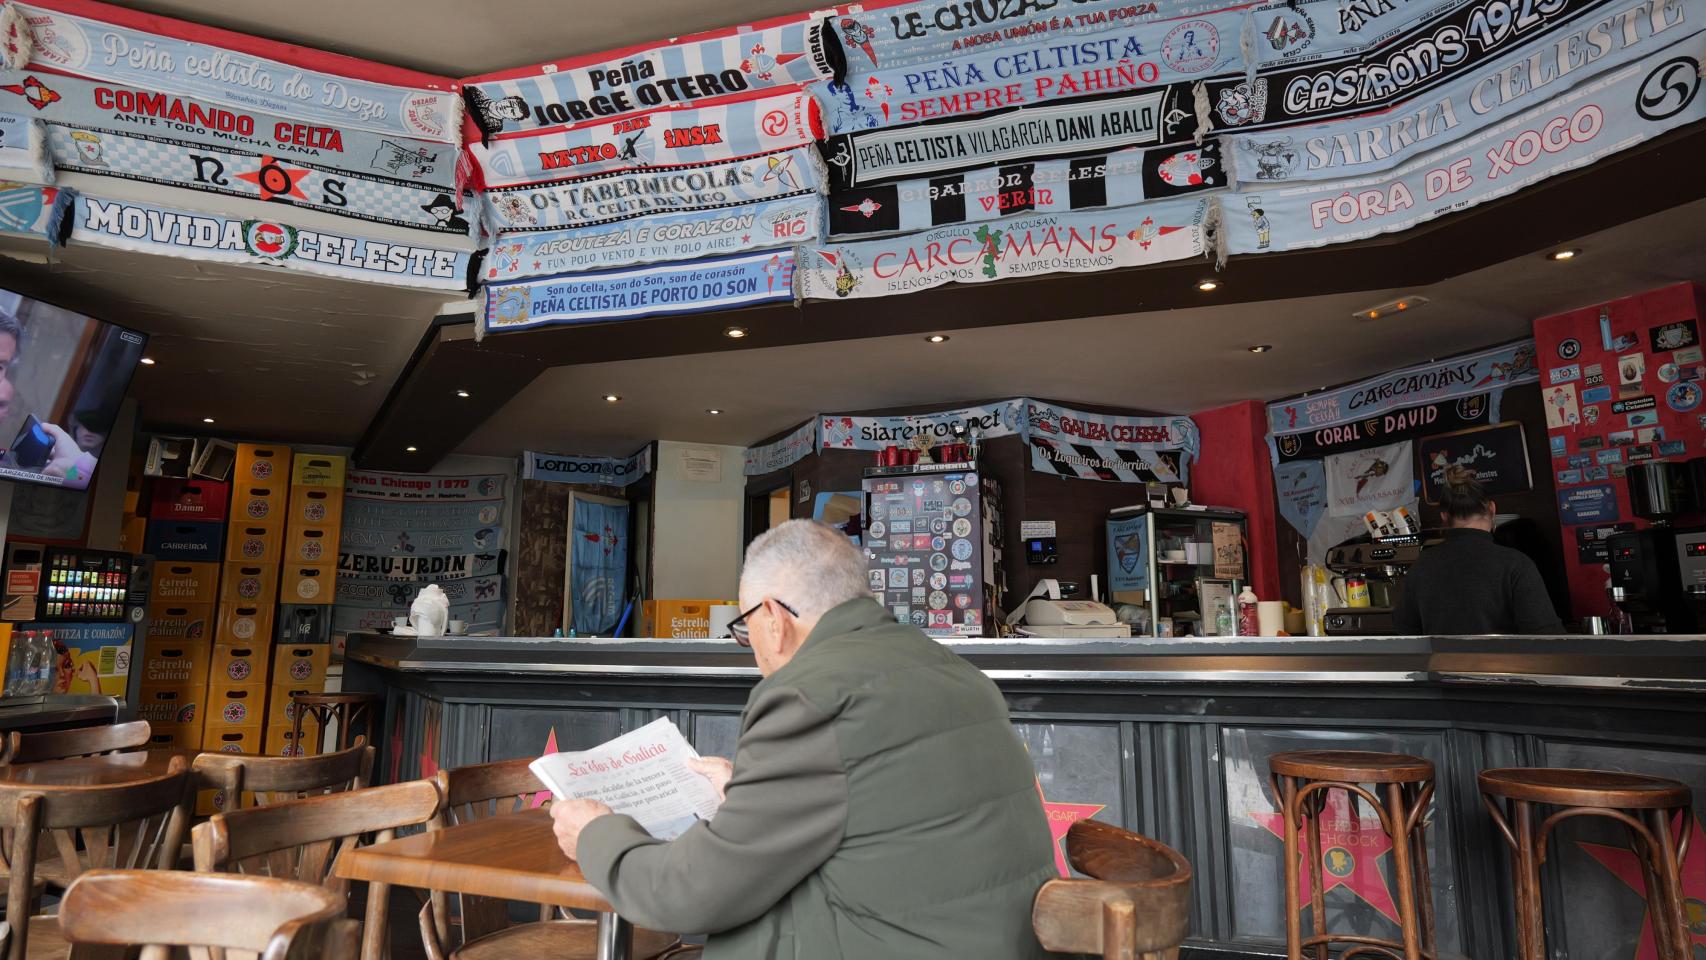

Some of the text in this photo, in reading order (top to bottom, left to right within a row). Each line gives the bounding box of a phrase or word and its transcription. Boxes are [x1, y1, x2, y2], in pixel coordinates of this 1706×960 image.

[890, 0, 1057, 40] LE-CHUZ
[951, 2, 1158, 51] A NOSA UNIÓN É A TUA FORZA
[808, 24, 833, 75] NIGRÁN
[904, 35, 1145, 96] PEÑA CELTISTA
[102, 32, 389, 120] Peña celtista do Deza
[588, 59, 656, 92] Peña
[900, 58, 1161, 121] SEMPRE PAHIÑO
[1306, 0, 1688, 171] SARRIA CELESTE
[534, 69, 749, 127] JORGE OTERO
[94, 87, 344, 154] COMANDO CELTA
[114, 113, 157, 126] ANTE
[164, 120, 206, 134] TODO
[213, 131, 271, 149] MUCHA
[859, 106, 1154, 169] PEÑA CELTISTA VILAGARCÍA DANI ABALO
[1031, 160, 1139, 184] CELESTE
[1311, 104, 1603, 229] FÓRA DE XOGO
[564, 164, 754, 206] TABERNICOLAS
[979, 189, 1054, 212] VERÍN
[565, 192, 726, 222] R.C. CELTA DE VIGO
[85, 197, 459, 279] MOVIDA CELESTE
[535, 213, 755, 257] AFOUTEZA E CORAZON
[872, 223, 1118, 280] CARCAMÄNS
[926, 228, 970, 242] ORGULLO
[547, 236, 736, 269] FUN POLO VENTO E VIN POLO AIRE!
[547, 265, 745, 296] Son do Celta, son do Son, son de corasón
[887, 274, 932, 291] ISLEÑOS
[933, 268, 974, 284] SOMOS
[1009, 260, 1049, 273] SEMPRE
[1063, 255, 1114, 268] SEREMOS
[532, 278, 757, 315] PEÑA CELTISTA DE PORTO DO SON
[1348, 361, 1479, 410] CARCAMÄNS
[1315, 404, 1438, 446] CORAL DAVID
[536, 458, 601, 473] LONDON
[1037, 446, 1052, 460] Os
[1054, 449, 1100, 469] Zoqueiros
[381, 475, 431, 490] Chicago
[438, 478, 469, 488] 1970
[174, 503, 204, 513] Damm
[159, 577, 198, 587] Estrella
[159, 586, 196, 597] Galicia
[53, 626, 126, 640] UTEZA E CORAZÓN!
[671, 616, 709, 629] Estrella
[671, 627, 708, 639] Galicia
[148, 659, 193, 669] Estrella
[148, 669, 189, 680] Galicia
[608, 757, 623, 769] de
[623, 743, 667, 765] Galicia
[1045, 809, 1080, 822] OGART
[1298, 831, 1378, 849] HCHCOCK
